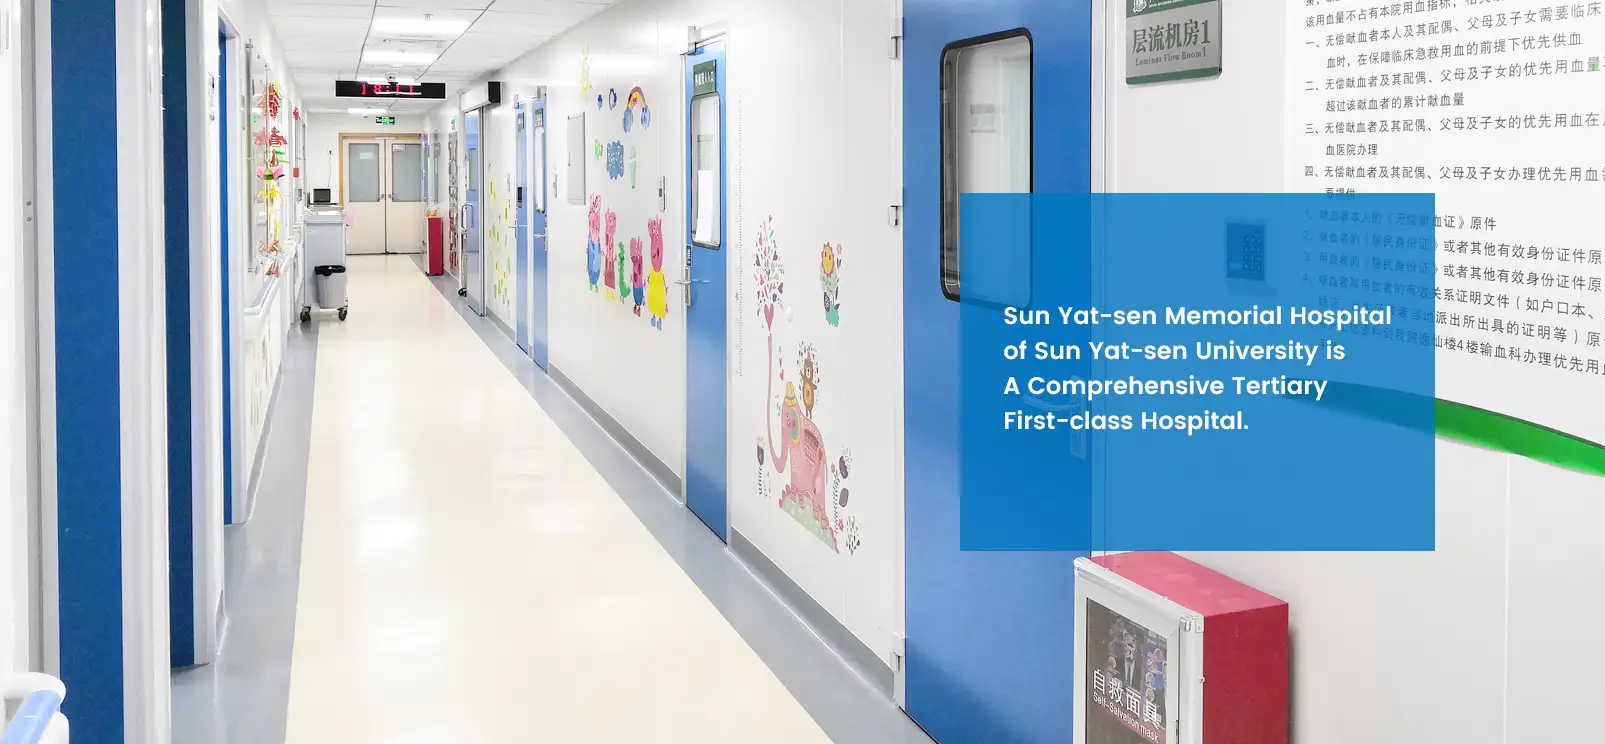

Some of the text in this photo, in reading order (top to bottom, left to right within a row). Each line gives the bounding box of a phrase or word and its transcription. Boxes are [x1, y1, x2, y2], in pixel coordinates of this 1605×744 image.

[1305, 0, 1503, 28] 该用血量不占有本院用血指标，
[1305, 1, 1605, 48] 一、无偿献血者本人及其配偶、父母及子女需要临床
[1132, 19, 1211, 54] 层流机房1
[1326, 31, 1583, 69] 血时，在保障临床急救用血的前提下优先供血
[1135, 57, 1162, 67] Laminar
[1163, 53, 1180, 63] Flow
[1305, 56, 1605, 91] 二、无偿献血者及其配偶、父母及子女的优先用血量
[1326, 92, 1465, 113] 超过该献血者的累计献血量
[1305, 111, 1605, 134] 三、无偿献血者及其配偶、父母及子女的优先用血在
[1325, 143, 1378, 156] 血医院办理
[1093, 668, 1160, 730] 自救面具
[1093, 691, 1159, 743] Self-Salvation mask
